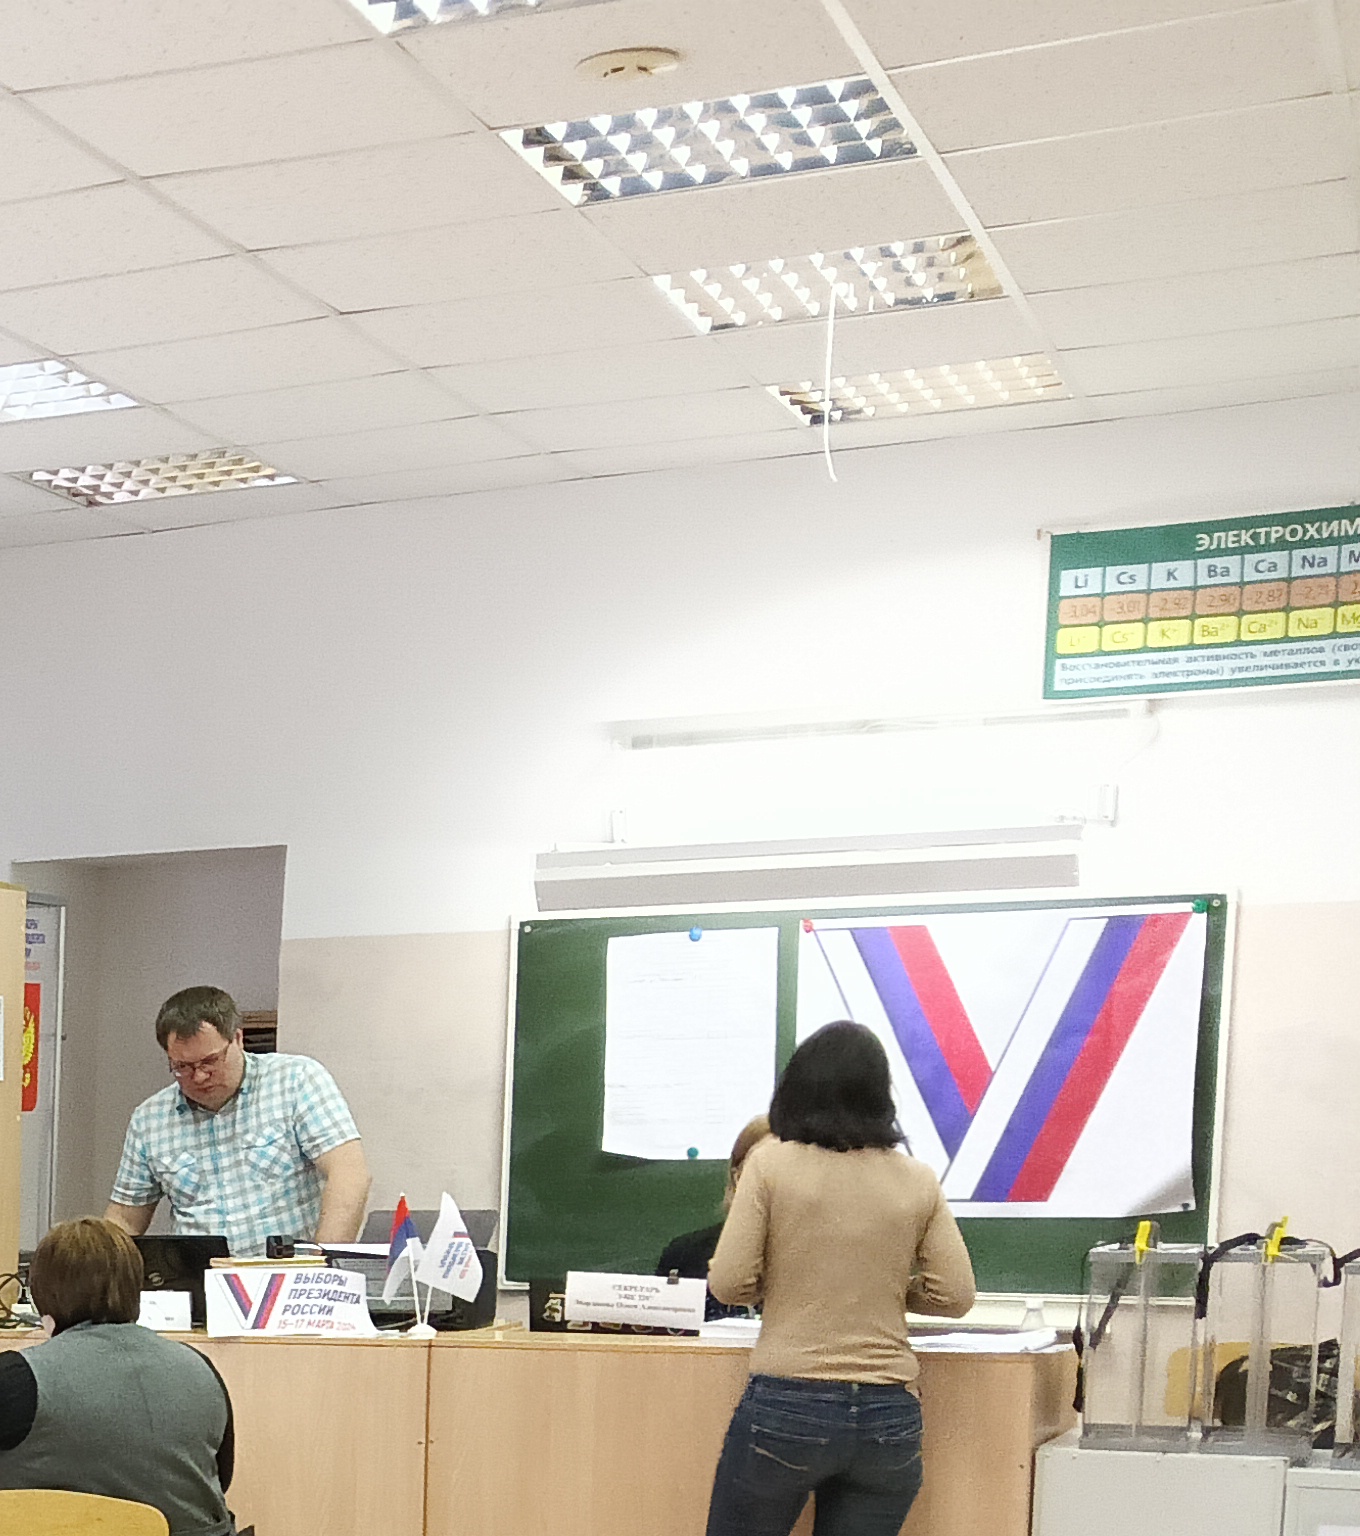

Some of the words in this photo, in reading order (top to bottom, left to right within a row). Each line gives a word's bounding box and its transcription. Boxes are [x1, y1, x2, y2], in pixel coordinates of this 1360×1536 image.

[1195, 517, 1360, 551] ЭЛЕКТРОХИМ
[1074, 573, 1089, 589] Li
[1116, 571, 1137, 585] Cs
[1166, 567, 1179, 582] K
[1207, 564, 1231, 578] Ba
[1254, 559, 1278, 574] Ca
[1301, 555, 1328, 570] Na
[293, 1272, 349, 1287] ВЫБОРЫ
[287, 1288, 361, 1305] ПРЕЗИДЕНТА
[281, 1303, 336, 1316] РОССИИ
